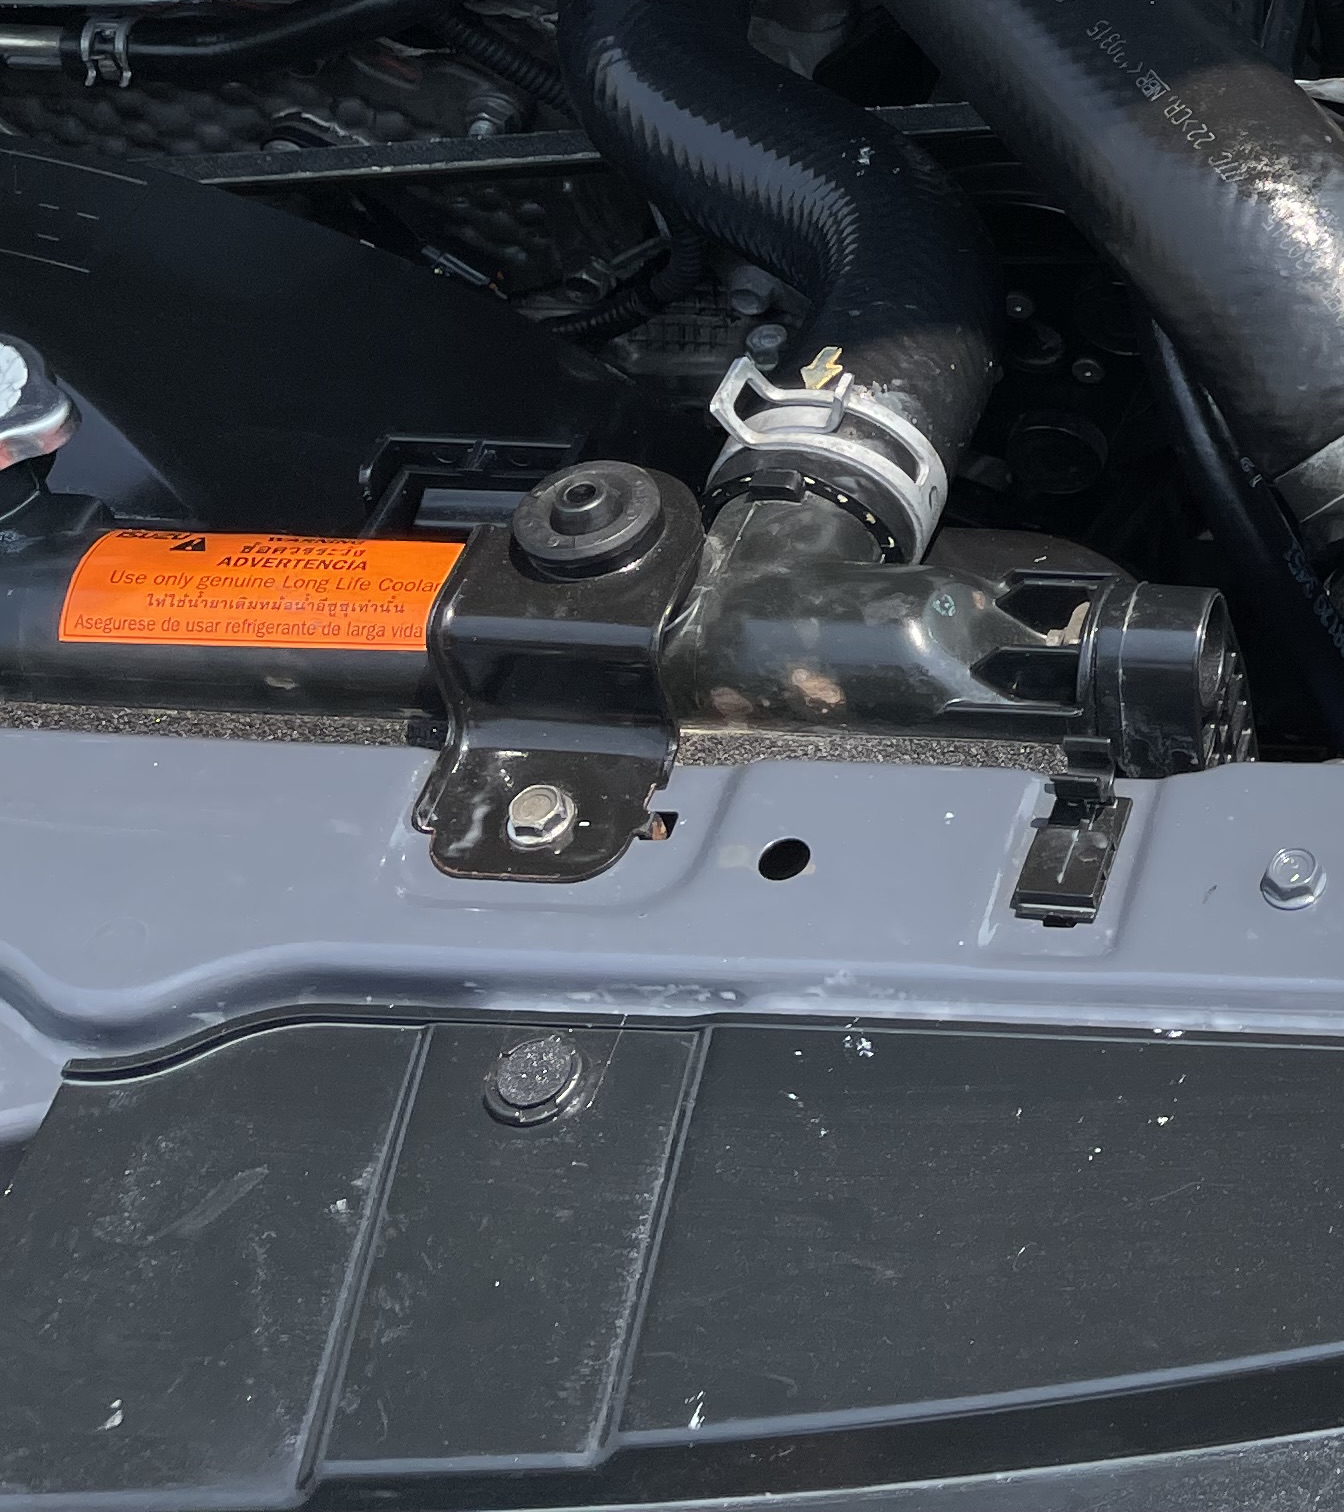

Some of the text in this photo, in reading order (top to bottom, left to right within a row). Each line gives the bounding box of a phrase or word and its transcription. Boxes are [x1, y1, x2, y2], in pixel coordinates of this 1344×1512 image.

[216, 556, 368, 572] ADVERTENCIA
[110, 569, 147, 585] Use
[153, 572, 194, 589] only
[199, 574, 276, 592] genuine
[283, 575, 330, 593] Long
[336, 577, 372, 592] Life
[74, 614, 424, 641] Asegurese de usar refrigerante de larga vida
